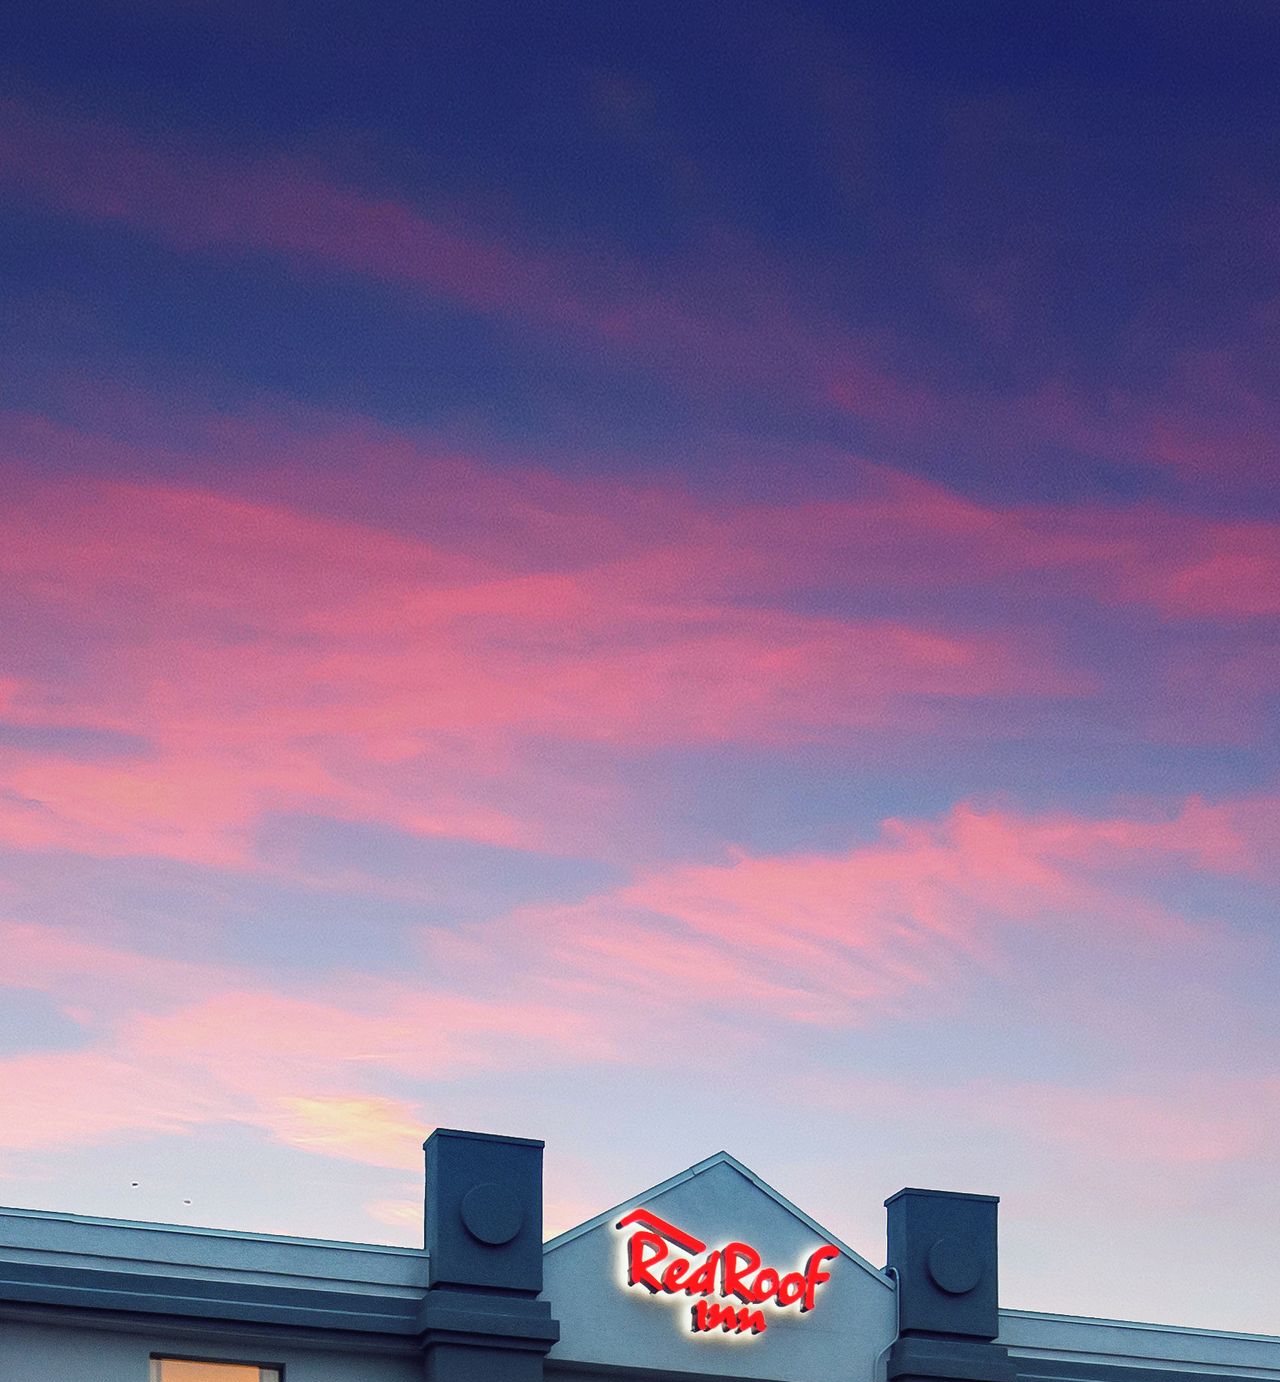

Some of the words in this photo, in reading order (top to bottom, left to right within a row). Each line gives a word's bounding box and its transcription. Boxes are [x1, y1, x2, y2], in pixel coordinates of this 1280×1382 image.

[628, 1231, 720, 1296] Red
[721, 1242, 840, 1312] Roof
[691, 1300, 766, 1334] Inn
